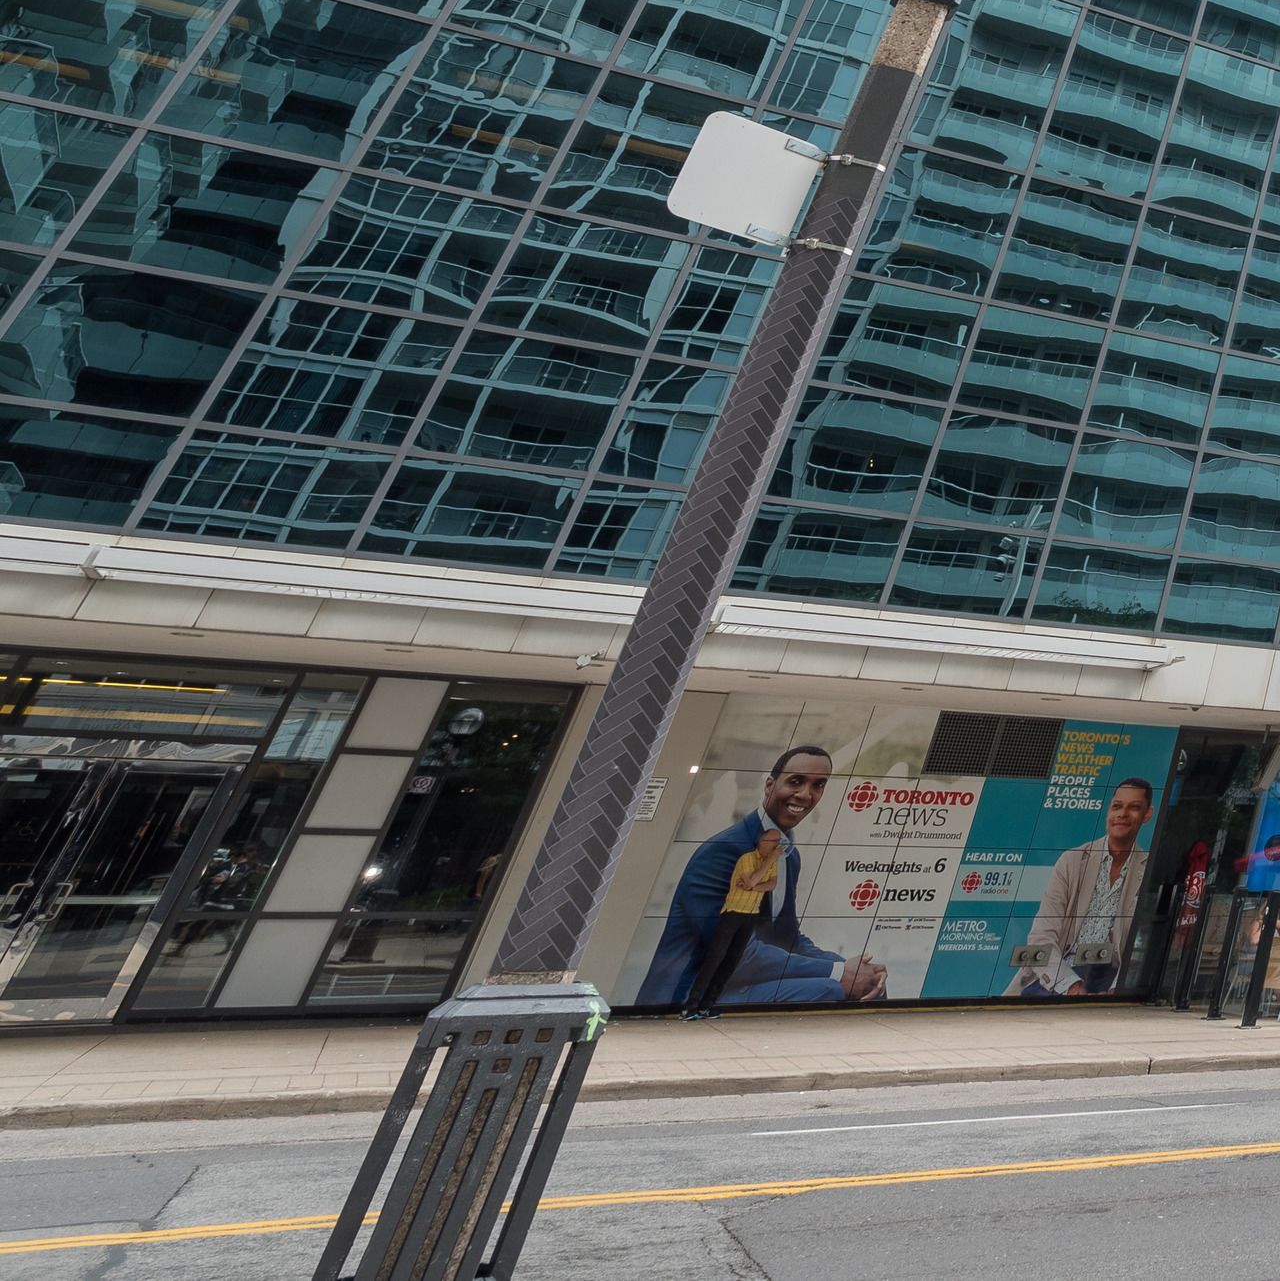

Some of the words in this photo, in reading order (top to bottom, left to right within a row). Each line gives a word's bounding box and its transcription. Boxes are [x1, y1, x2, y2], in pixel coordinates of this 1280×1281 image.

[1063, 731, 1131, 746] TORONTO'S
[1060, 742, 1095, 754] NEWS
[1057, 753, 1113, 765] WEATHER
[1054, 764, 1102, 776] TRAFFIC
[1050, 776, 1096, 786] PEOPLE
[883, 789, 975, 806] TORONTO
[1047, 786, 1091, 798] PLACES
[1043, 798, 1053, 808] &
[1054, 798, 1103, 810] STORIES
[873, 806, 949, 827] news
[882, 830, 913, 840] Dwight
[914, 831, 962, 840] Drummond
[965, 853, 994, 862] HEAR
[995, 853, 1005, 862] IT
[1005, 854, 1023, 862] ON
[845, 860, 922, 875] Weeknights
[934, 858, 948, 873] 6
[984, 871, 1009, 886] 99.1
[883, 888, 936, 902] news
[943, 920, 987, 932] METRO
[940, 932, 984, 941] MORNING
